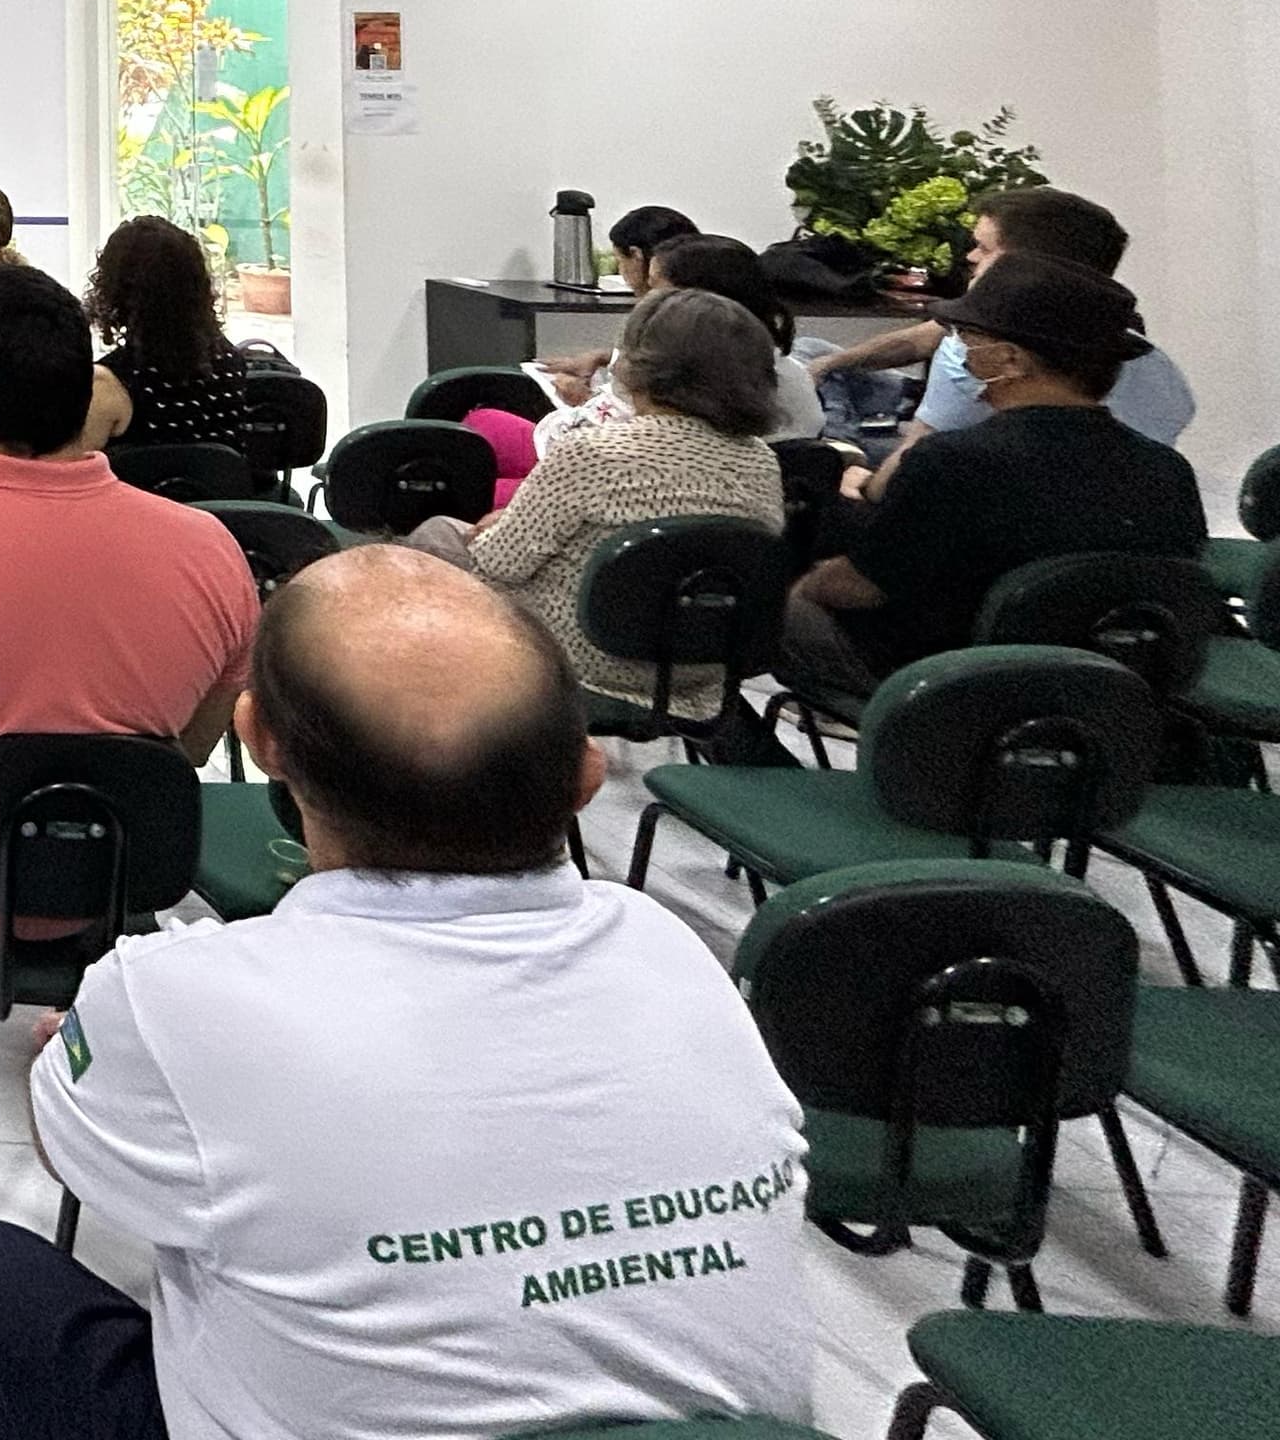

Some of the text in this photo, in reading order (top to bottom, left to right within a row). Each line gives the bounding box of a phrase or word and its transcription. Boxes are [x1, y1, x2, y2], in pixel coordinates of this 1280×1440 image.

[366, 1157, 794, 1264] CENTRO DE EDUCAÇÃO
[521, 1239, 747, 1308] AMBIENTAL
